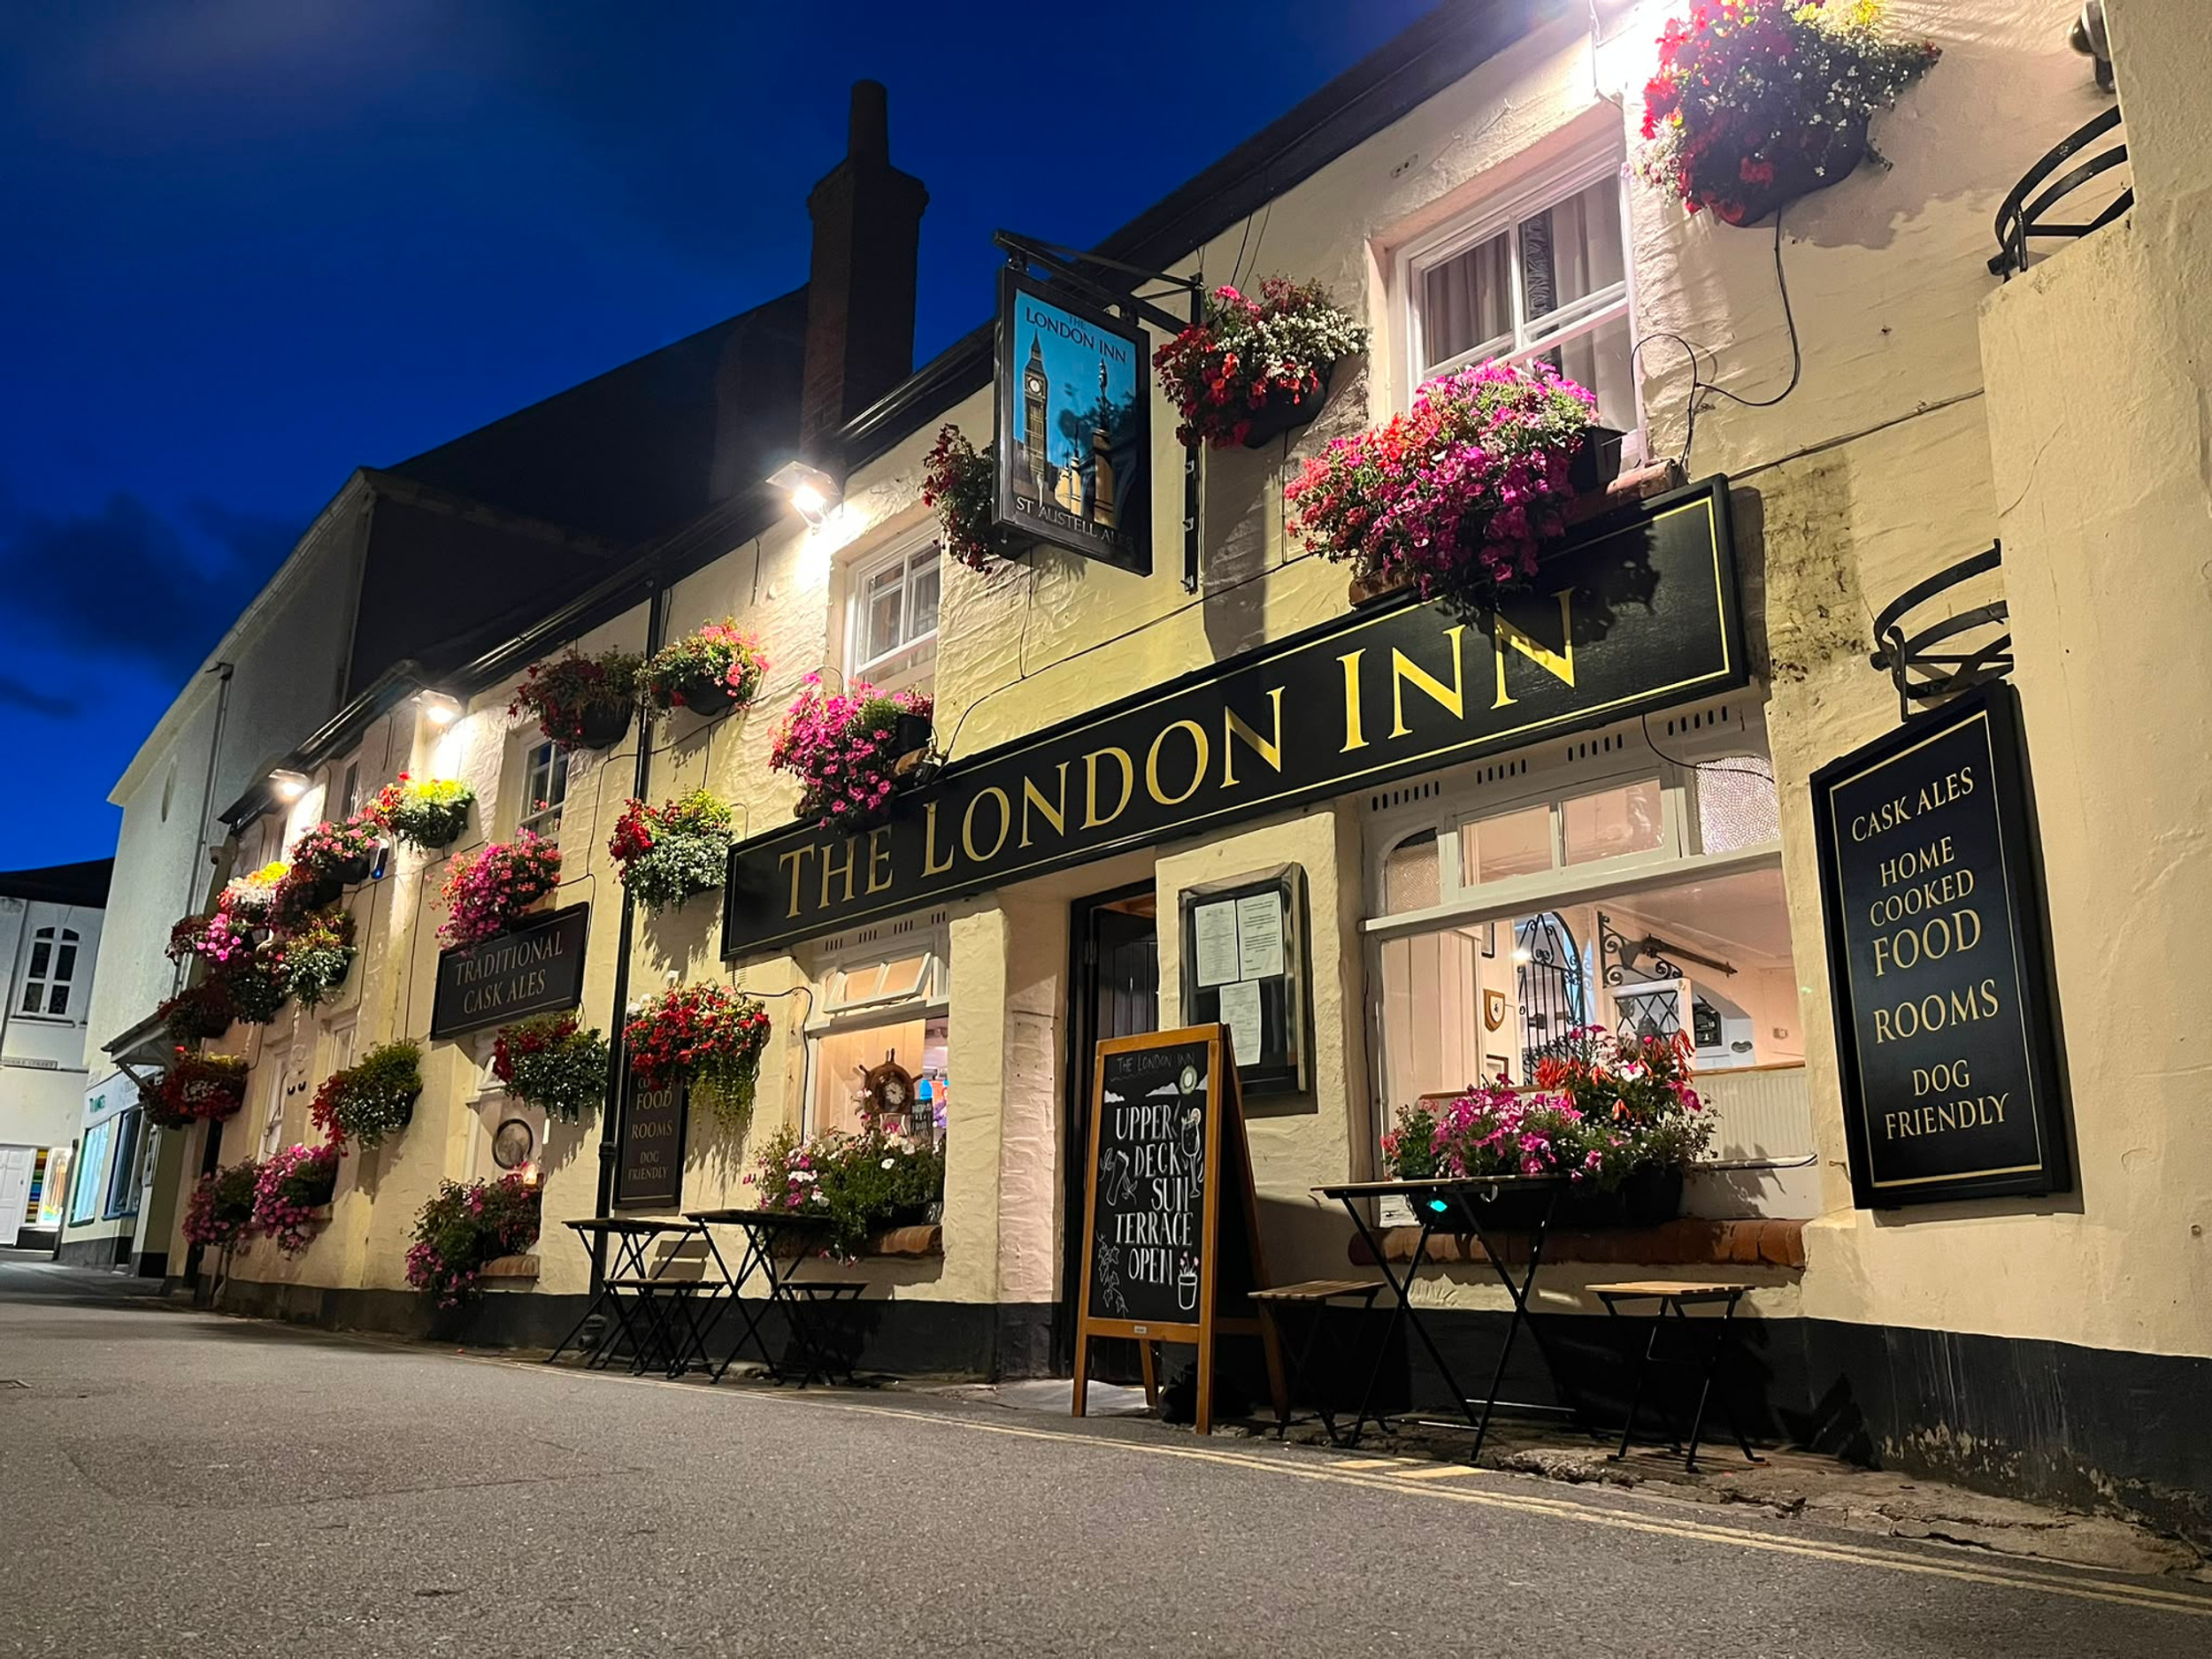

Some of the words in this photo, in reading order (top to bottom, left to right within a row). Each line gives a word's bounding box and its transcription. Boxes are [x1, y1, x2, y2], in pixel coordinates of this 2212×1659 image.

[1026, 306, 1094, 350] LONDON
[1099, 339, 1126, 365] INN
[1069, 315, 1087, 330] THE
[1016, 495, 1034, 514] ST
[1038, 505, 1097, 537] AUSTELL
[778, 823, 894, 919] THE
[920, 685, 1286, 879] LONDON
[1335, 586, 1577, 753] INN
[1851, 795, 1912, 843] CASK
[1916, 765, 1976, 816] ALES
[1880, 835, 1955, 889] HOME
[1869, 867, 1976, 928] COOKED
[455, 931, 564, 987] TRADITIONAL
[1872, 907, 1983, 978] FOOD
[464, 979, 503, 1014] CASK
[506, 968, 547, 1002] ALES
[1873, 978, 2001, 1045] ROOMS
[1117, 1056, 1133, 1073] THE
[1911, 1058, 1971, 1098] DOG
[635, 1089, 673, 1111] FOOD
[1884, 1091, 2011, 1141] FRIENDLY
[631, 1119, 673, 1140] ROOMS
[1116, 1104, 1173, 1141] UPPER
[628, 1166, 670, 1181] FRIENDLY
[640, 1150, 660, 1164] DOG
[1134, 1141, 1182, 1179] DECK
[1150, 1177, 1188, 1212] SUN
[1115, 1211, 1194, 1247] TERRACE
[1128, 1248, 1173, 1286] OPEN
